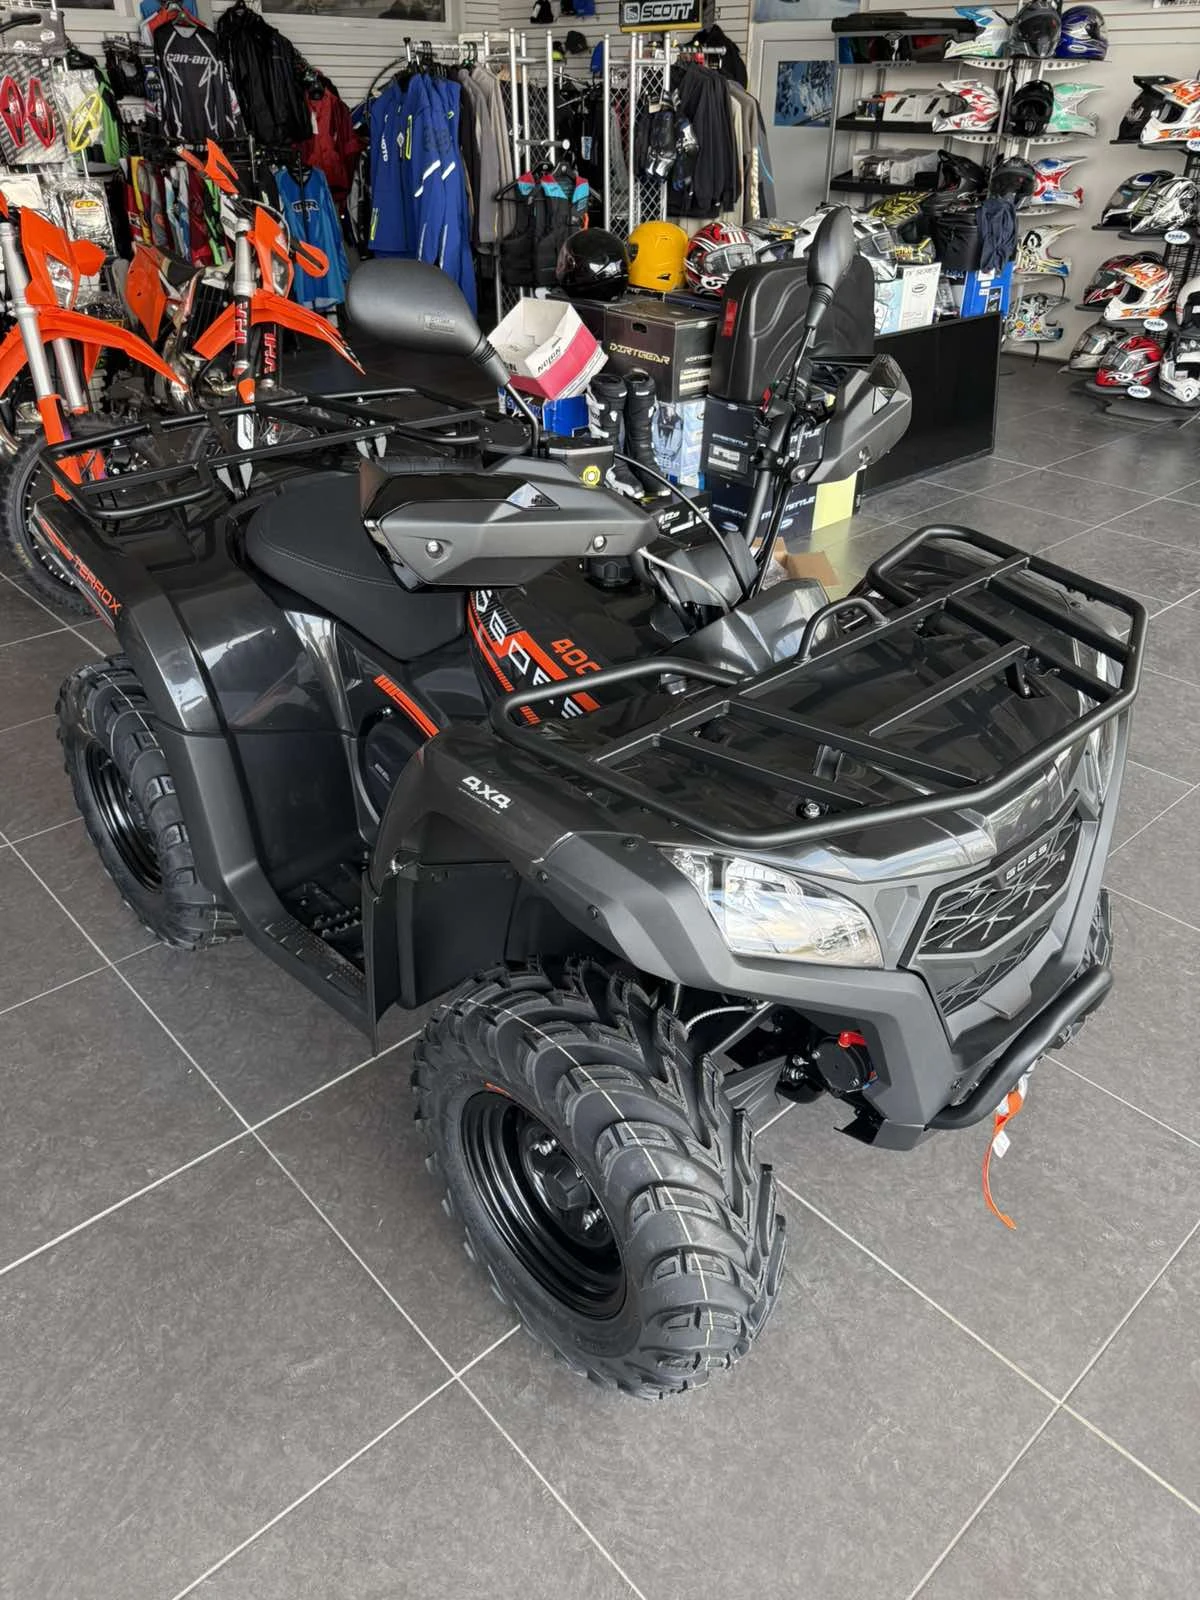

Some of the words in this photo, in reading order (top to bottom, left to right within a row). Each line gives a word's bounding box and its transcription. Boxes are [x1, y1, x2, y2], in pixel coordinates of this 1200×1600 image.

[641, 1, 693, 20] SCOTT
[609, 342, 671, 365] DIRTGEAR
[1006, 842, 1048, 880] GOES
